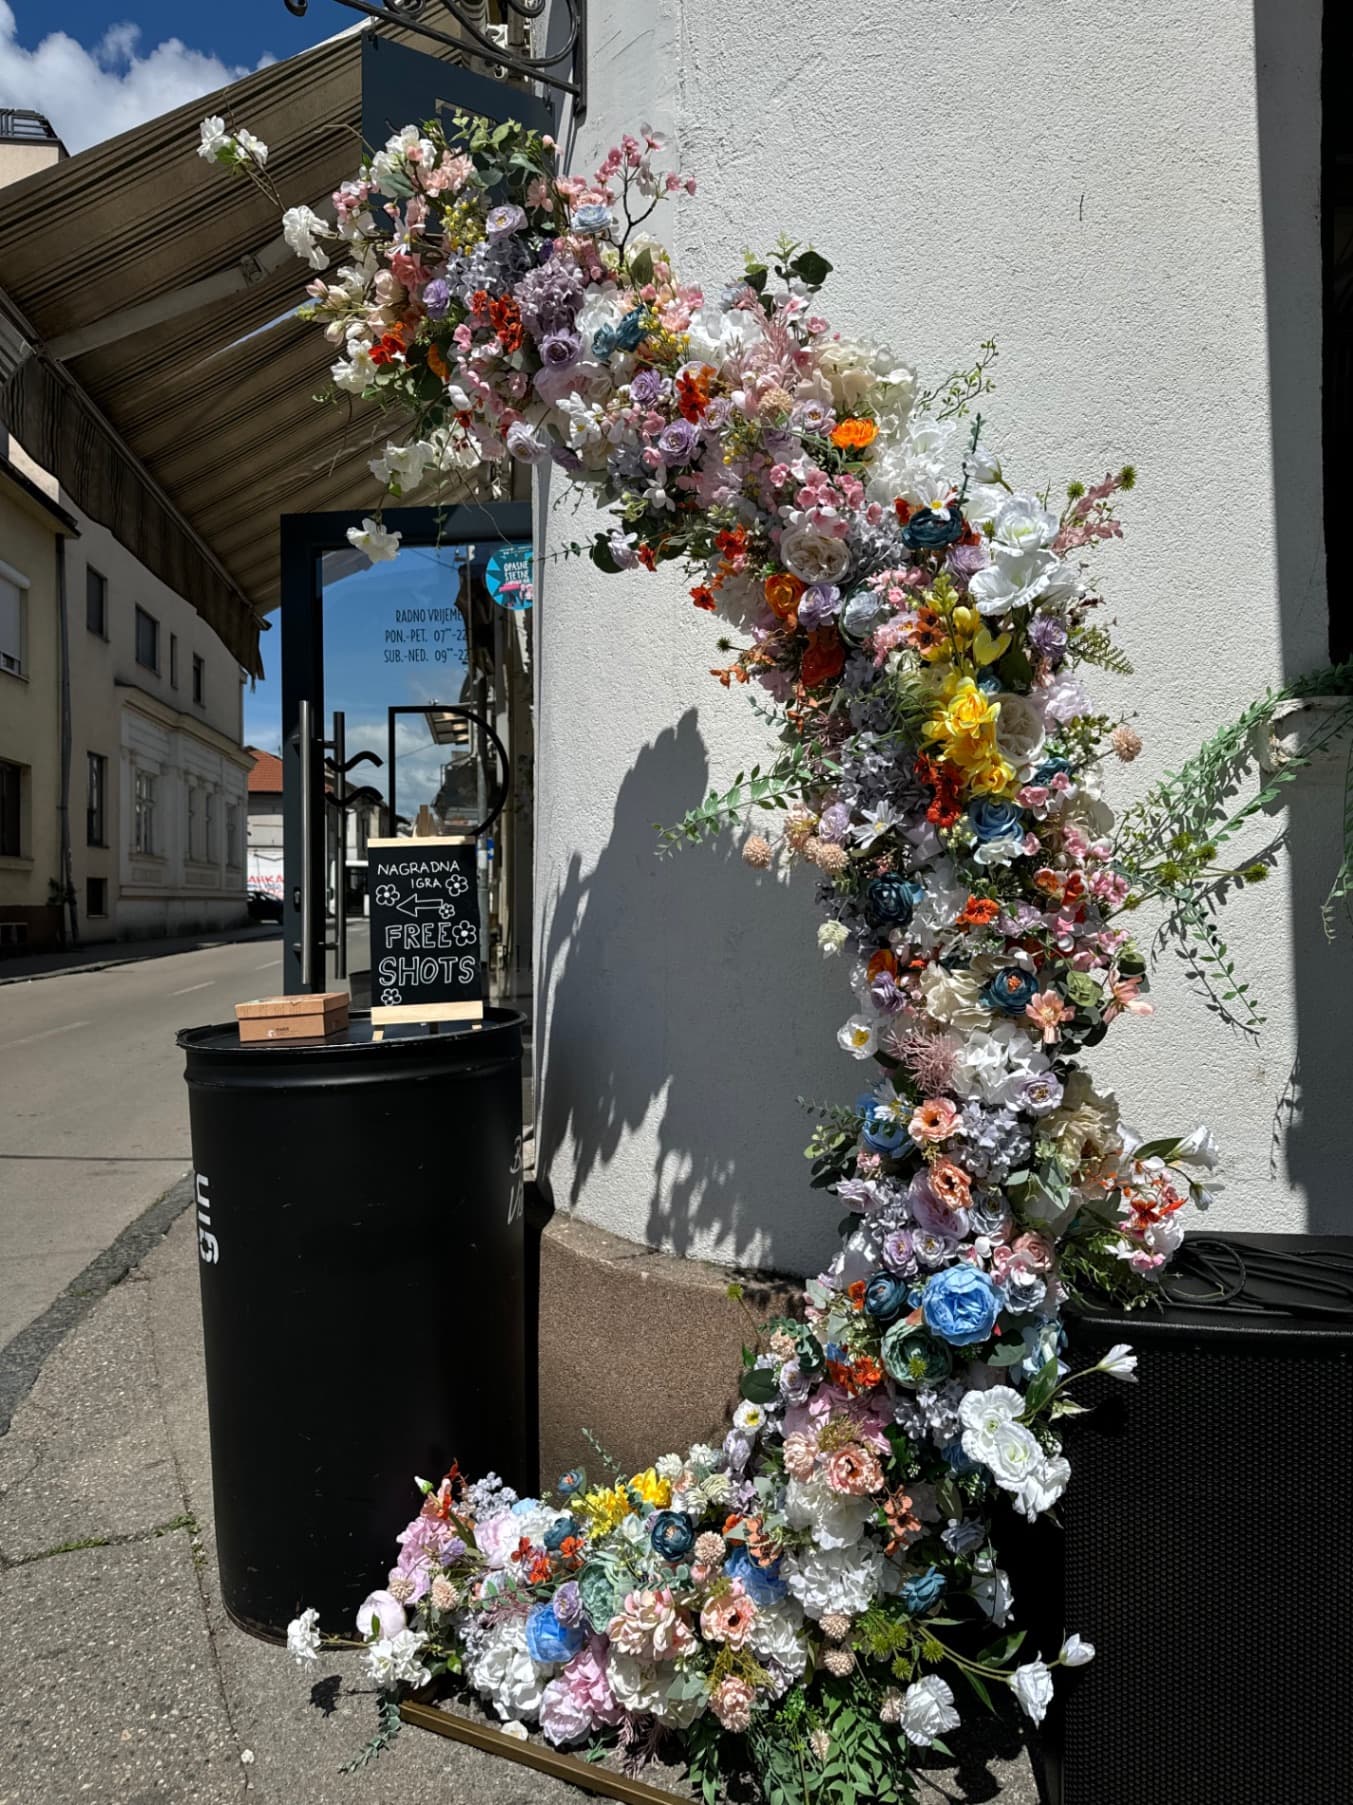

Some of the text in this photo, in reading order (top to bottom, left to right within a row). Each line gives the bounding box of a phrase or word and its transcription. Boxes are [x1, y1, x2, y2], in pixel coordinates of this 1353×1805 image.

[395, 608, 463, 625] RADNO VRIJEME
[377, 860, 460, 876] NAGRADNA
[410, 877, 442, 889] IGRA
[384, 922, 452, 949] FREE
[378, 955, 476, 987] SHOTS
